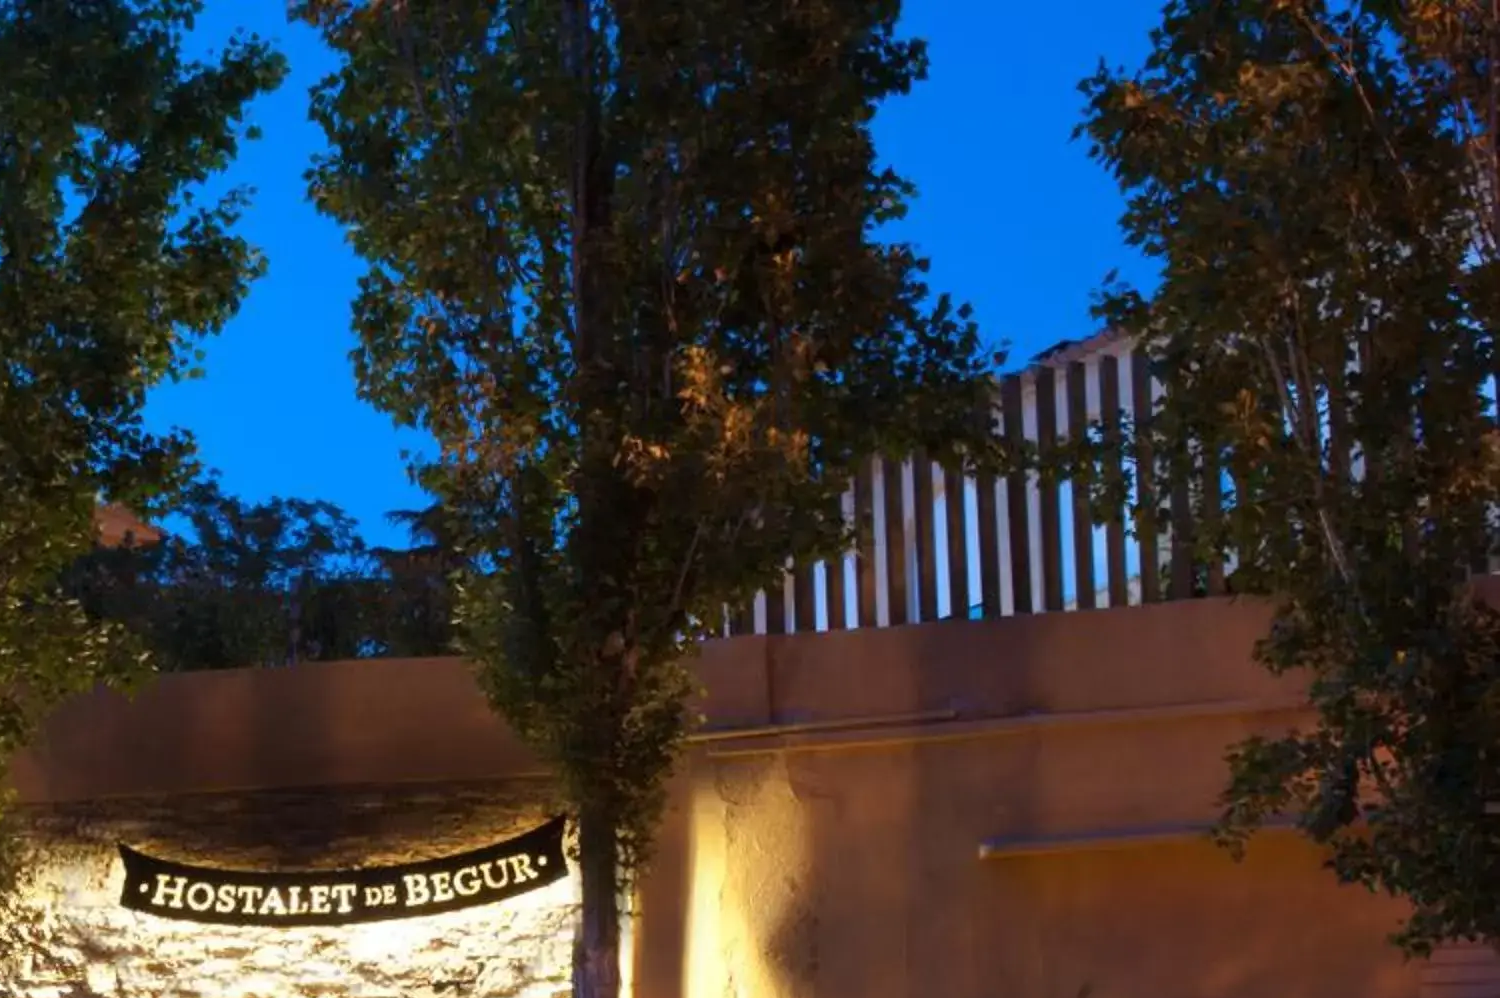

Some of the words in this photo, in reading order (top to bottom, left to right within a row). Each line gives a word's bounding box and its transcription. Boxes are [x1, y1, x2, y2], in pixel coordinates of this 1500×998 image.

[151, 873, 357, 915] HOSTALET
[364, 884, 397, 907] DE
[402, 852, 541, 907] BEGUR
